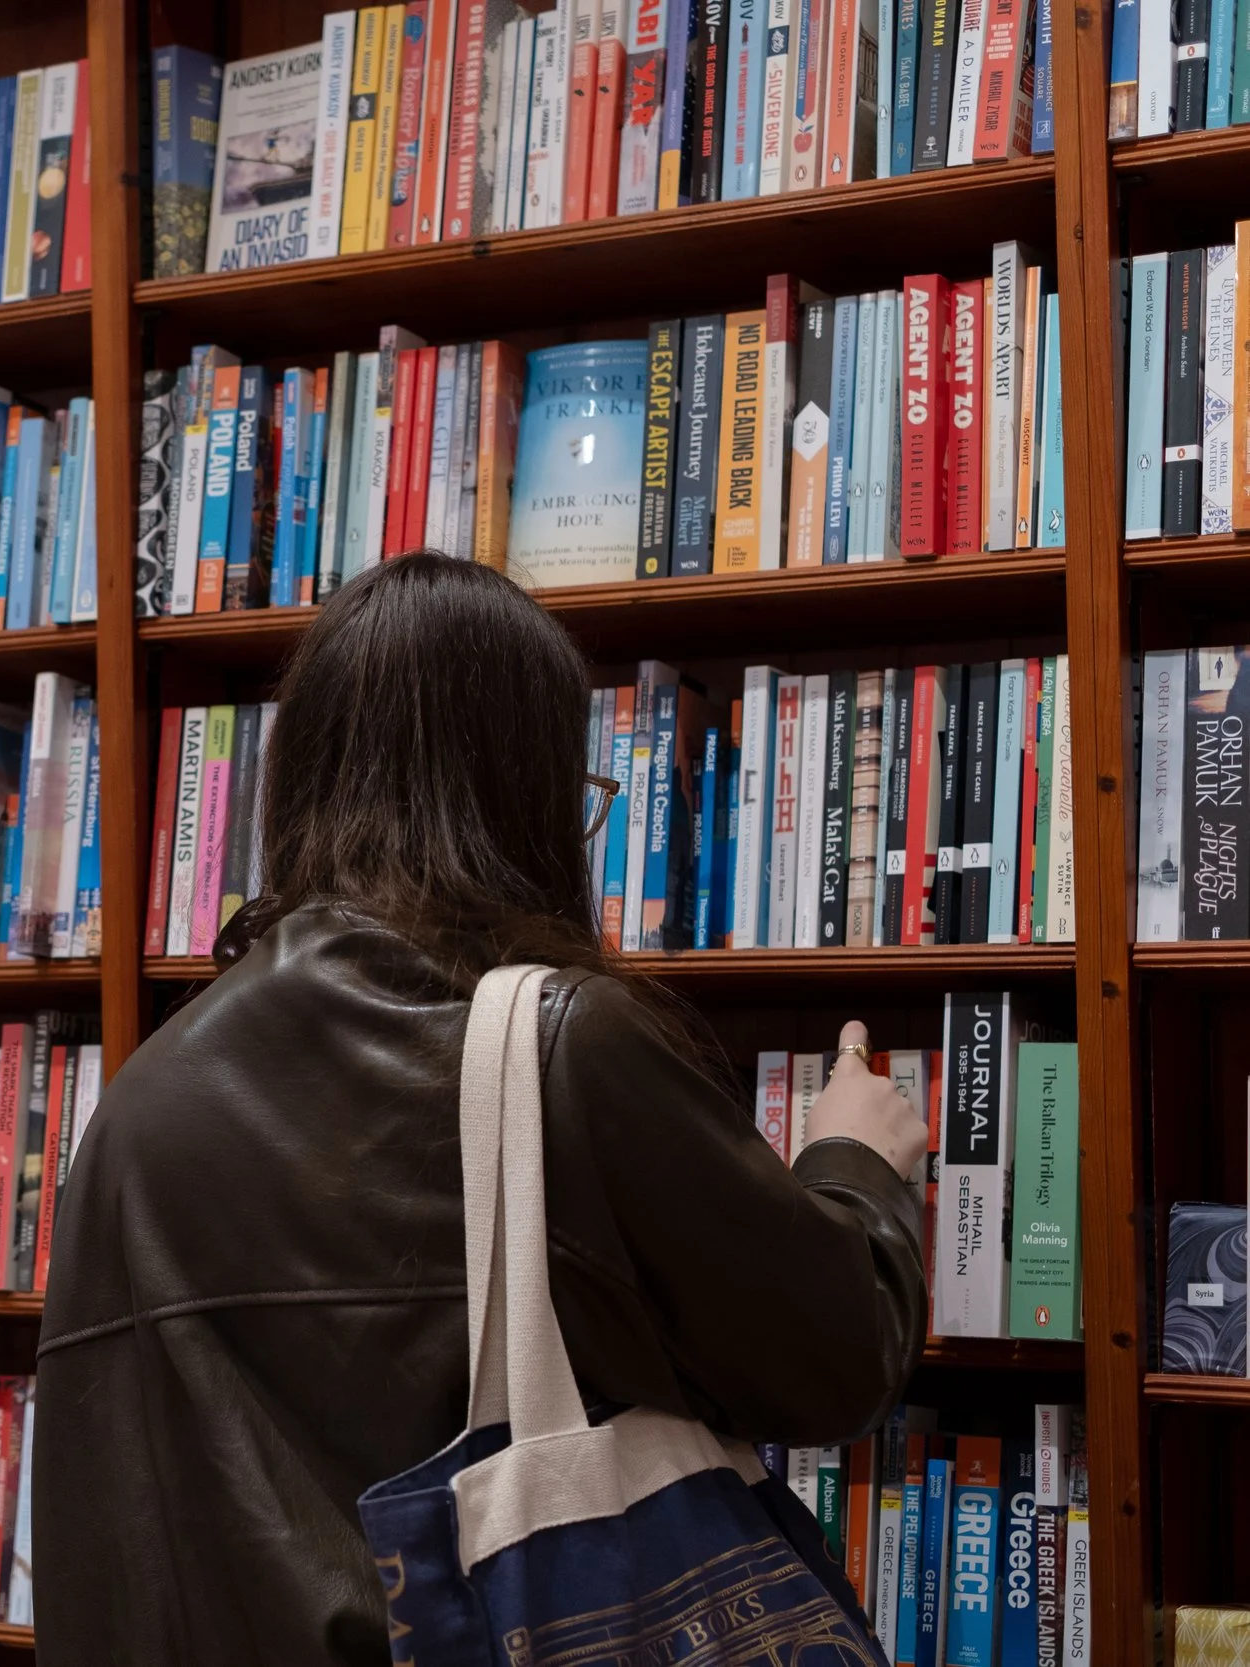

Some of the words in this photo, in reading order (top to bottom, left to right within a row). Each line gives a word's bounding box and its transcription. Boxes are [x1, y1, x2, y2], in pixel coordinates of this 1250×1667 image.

[229, 64, 284, 89] ANDREY
[463, 40, 481, 107] ENEMIES
[630, 59, 657, 127] YAR
[767, 69, 783, 118] SILVER
[987, 70, 1004, 103] MIKHAIL
[400, 66, 422, 137] Rooster
[958, 75, 972, 122] MILLER
[984, 105, 1000, 131] ZYGAR
[460, 112, 476, 149] WILL
[764, 122, 780, 159] BONE
[393, 140, 417, 200] House
[456, 155, 474, 210] VANISH
[235, 213, 283, 245] DIARY
[288, 207, 308, 232] OF
[219, 245, 243, 271] AN
[996, 258, 1011, 336] WORLDS
[1145, 270, 1155, 301] Edward
[1209, 295, 1221, 321] THE
[657, 328, 670, 346] THE
[738, 323, 761, 344] NO
[908, 288, 929, 381] AGENT
[954, 293, 974, 385] AGENT
[1145, 314, 1154, 332] Said
[693, 325, 713, 410] Holocaust
[1221, 317, 1233, 377] BETWEEN
[649, 351, 673, 420] ESCAPE
[735, 350, 760, 393] ROAD
[995, 341, 1011, 401] APART
[436, 380, 453, 415] The
[907, 388, 928, 425] ZO
[953, 391, 973, 429] ZO
[236, 409, 257, 471] Poland
[683, 407, 708, 481] Journey
[731, 397, 757, 462] LEADING
[1022, 417, 1030, 466] AUSCHWITZ
[186, 448, 200, 502] POLAND
[207, 413, 235, 496] POLAND
[431, 426, 450, 483] GIFT
[646, 426, 667, 489] ARTIST
[911, 434, 924, 471] CLARE
[957, 438, 970, 475] CLARE
[1219, 441, 1229, 486] MICHAEL
[728, 467, 753, 510] BACK
[831, 456, 844, 498] PRIMO
[557, 514, 603, 528] HOPE
[653, 494, 665, 545] JONATHAN
[678, 496, 693, 547] Gilbert
[691, 496, 706, 545] Martin
[830, 501, 843, 528] LEVI
[910, 481, 923, 528] MULLEY
[956, 484, 969, 531] MULLEY
[1007, 676, 1016, 697] Franz
[1043, 667, 1054, 692] MILAN
[1157, 671, 1170, 733] ORHAN
[833, 690, 846, 721] Mala
[898, 698, 907, 724] FRANZ
[947, 704, 956, 729] FRANZ
[975, 701, 984, 726] FRANZ
[1006, 699, 1016, 723] Kafka
[1042, 695, 1053, 736] KUNDERA
[655, 730, 672, 780] Prague
[705, 734, 716, 772] PRAGUE
[828, 724, 843, 790] Kacenberg
[898, 725, 906, 750] KAFKA
[946, 731, 955, 756] KAFKA
[975, 727, 983, 752] KAFKA
[182, 720, 202, 802] MARTIN
[945, 764, 954, 778] THE
[974, 761, 982, 775] THE
[1155, 739, 1168, 798] PAMUK
[1195, 720, 1219, 807] PAMUK
[1219, 716, 1244, 806] ORHAN
[63, 745, 83, 824] RUSSIA
[632, 772, 646, 828] PRAGUE
[656, 782, 670, 792] &
[944, 779, 952, 800] TRIAL
[973, 776, 981, 803] CASTLE
[81, 773, 99, 847] Petersburg
[651, 796, 667, 852] Czechia
[1157, 807, 1165, 836] SNOW
[177, 807, 195, 862] AMIS
[824, 807, 843, 865] Mala's
[778, 843, 787, 875] Laurent
[1057, 865, 1065, 894] SUTIN
[1064, 851, 1072, 906] LAWRENCE
[1193, 837, 1218, 915] PLAGUE
[1218, 823, 1237, 900] NIGHTS
[778, 879, 786, 902] Binet
[822, 868, 841, 904] Cat
[699, 897, 708, 926] Thomas
[698, 926, 707, 947] Cook
[766, 1066, 785, 1101] THE
[971, 1003, 992, 1151] JOURNAL
[1042, 1063, 1057, 1095] The
[1041, 1097, 1056, 1151] Balkan
[46, 1132, 57, 1189] CATHERINE
[1036, 1152, 1055, 1209] Trilogy
[44, 1191, 54, 1225] GRACE
[956, 1175, 970, 1277] SEBASTIAN
[971, 1196, 983, 1256] MIHAIL
[1030, 1222, 1060, 1233] Olivia
[41, 1227, 50, 1251] KATZ
[1022, 1233, 1068, 1247] Manning
[1194, 1289, 1215, 1299] Syria
[1041, 1411, 1051, 1446] INSIGHT
[823, 1475, 835, 1523] Albania
[929, 1475, 937, 1498] planet
[934, 1475, 942, 1498] lonely
[1041, 1462, 1051, 1494] GUIDES
[905, 1490, 919, 1512] THE
[1007, 1491, 1036, 1608] Greece
[1038, 1513, 1055, 1541] THE
[883, 1526, 895, 1575] GREECE
[902, 1515, 918, 1599] PELOPONNESE
[954, 1492, 992, 1613] GREECE
[1038, 1546, 1055, 1596] GREEK
[1073, 1539, 1087, 1588] GREEK
[922, 1569, 935, 1633] GREECE
[1038, 1599, 1055, 1667] ISLANDS
[1071, 1592, 1084, 1658] ISLANDS
